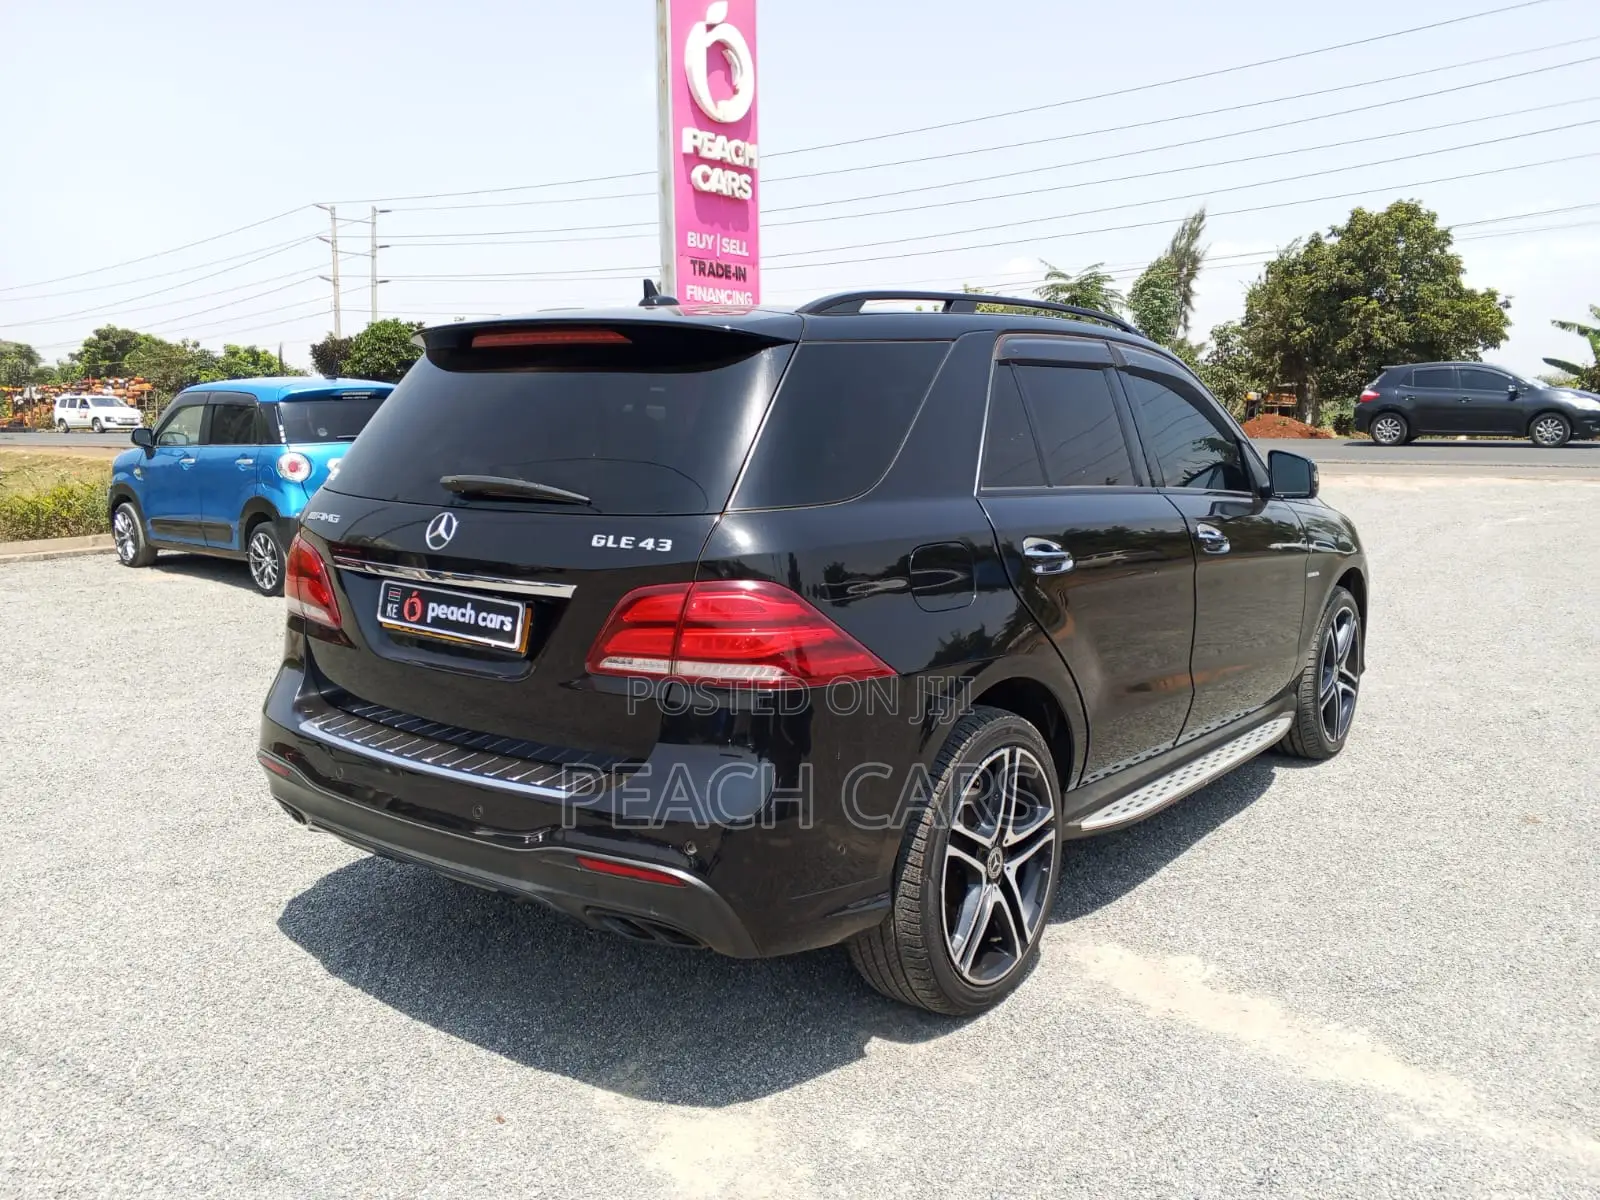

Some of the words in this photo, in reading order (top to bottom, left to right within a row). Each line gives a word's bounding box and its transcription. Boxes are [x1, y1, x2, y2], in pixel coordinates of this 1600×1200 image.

[682, 127, 758, 168] PEACH
[691, 164, 752, 200] CARS
[687, 231, 714, 250] BUY
[721, 237, 749, 256] SELL
[690, 259, 747, 282] TRADE-IN
[686, 284, 753, 305] FINANCING
[591, 534, 636, 549] GLE
[638, 537, 673, 552] 43
[386, 603, 399, 618] KE
[426, 602, 476, 624] peach
[477, 612, 513, 631] cars
